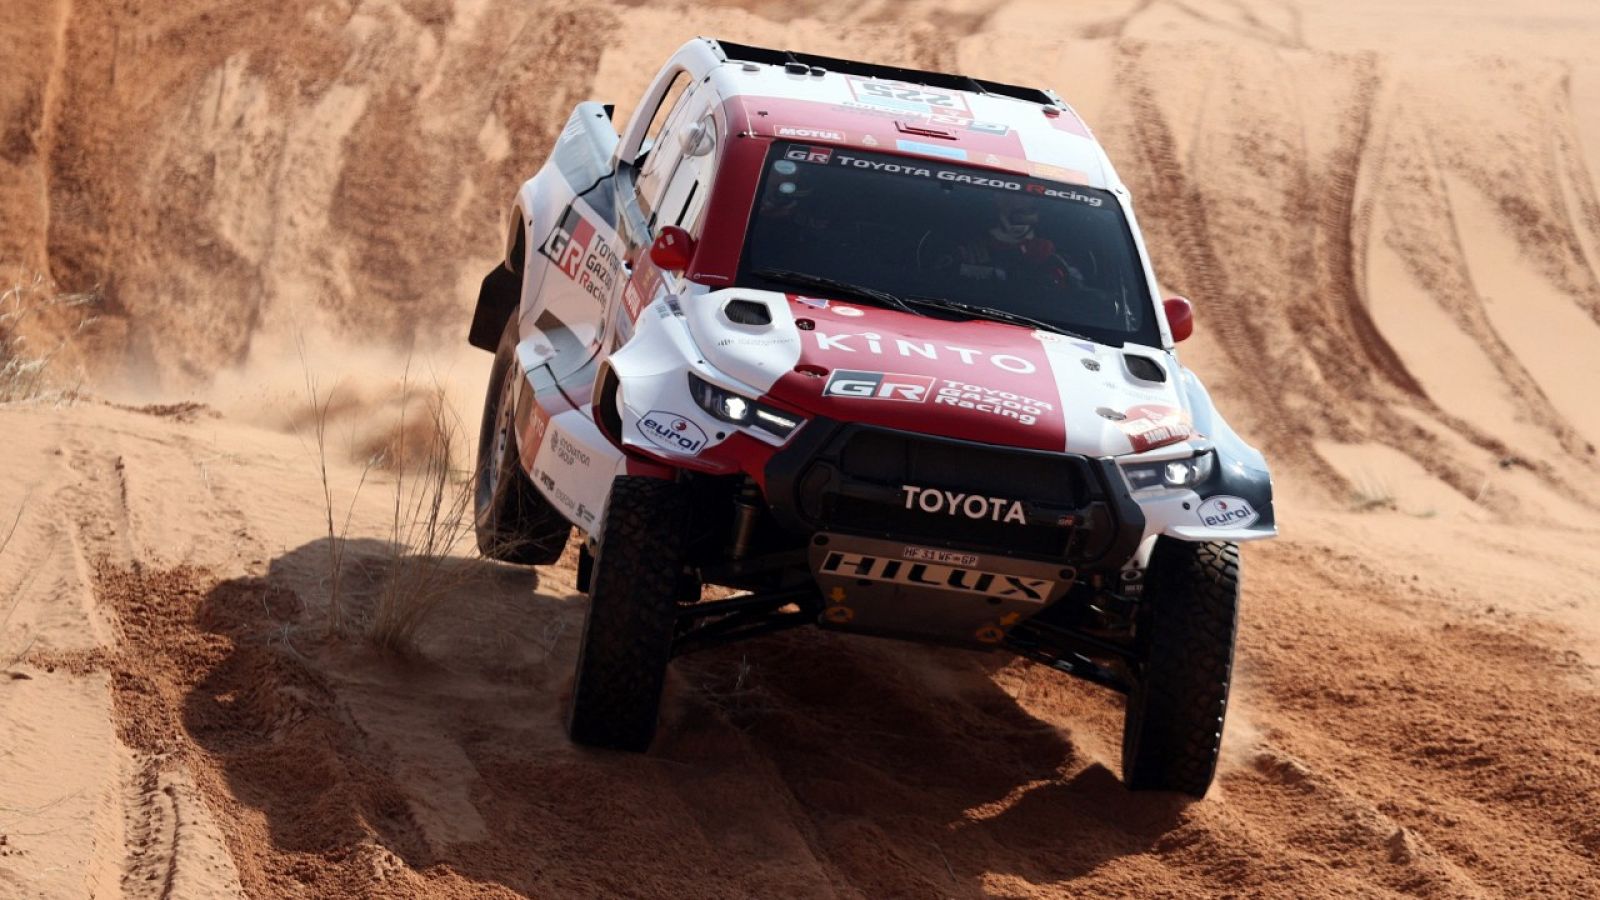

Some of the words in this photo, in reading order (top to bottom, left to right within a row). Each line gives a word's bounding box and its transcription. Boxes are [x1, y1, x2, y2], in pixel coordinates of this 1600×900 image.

[779, 127, 842, 140] MOTUL
[786, 149, 830, 163] GR
[836, 155, 930, 177] TOYOTA
[936, 170, 1021, 191] GAZOO
[1025, 183, 1103, 207] Racing
[544, 226, 585, 279] GR
[828, 379, 926, 401] GR
[938, 388, 1042, 415] GAZOO
[942, 380, 1053, 411] TOYOTA
[935, 395, 1037, 426] Racing
[643, 419, 700, 451] eurol
[902, 485, 1027, 525] TOYOTA
[1205, 505, 1251, 526] eurol
[823, 552, 1045, 600] HILUX
